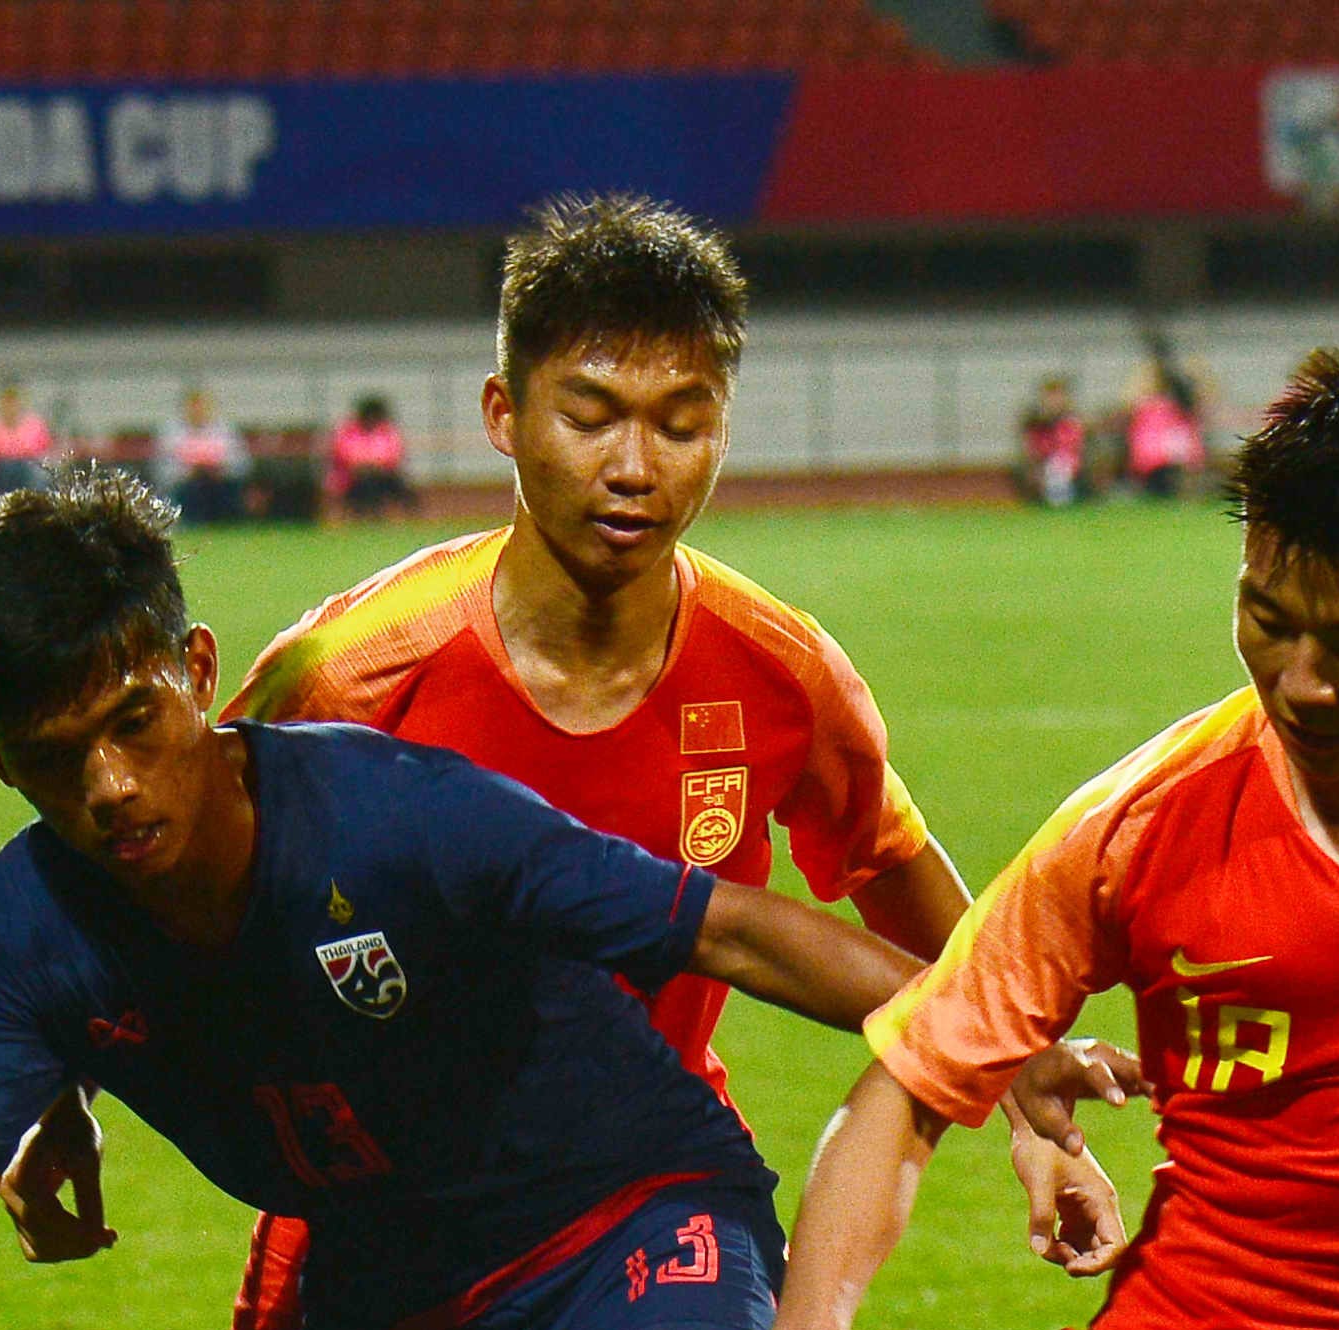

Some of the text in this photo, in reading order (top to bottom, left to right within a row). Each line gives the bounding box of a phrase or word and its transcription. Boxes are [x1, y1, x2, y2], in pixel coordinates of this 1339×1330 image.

[105, 94, 273, 202] CUP
[686, 773, 742, 797] CFA
[320, 936, 383, 961] THAILAND
